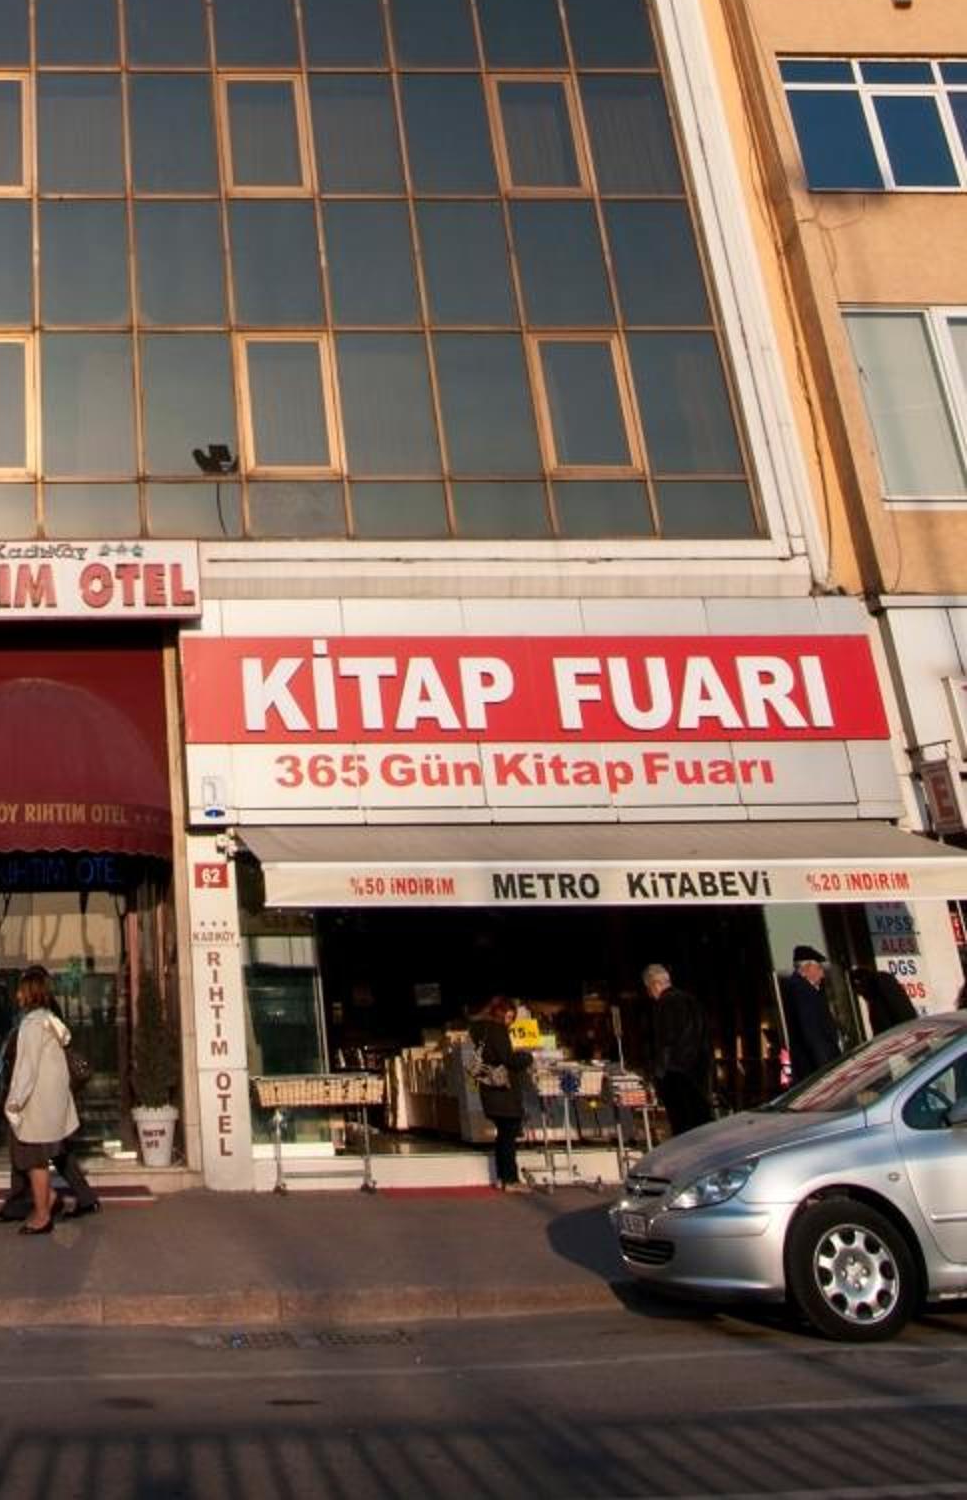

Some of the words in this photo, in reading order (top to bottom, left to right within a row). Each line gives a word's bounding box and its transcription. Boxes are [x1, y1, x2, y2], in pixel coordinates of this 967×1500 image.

[79, 563, 196, 609] OTEL
[241, 638, 515, 731] KİTAP
[552, 655, 835, 731] FUARI
[275, 754, 370, 788] 365
[380, 753, 483, 787] Gün
[492, 752, 634, 793] Kitap
[24, 803, 85, 824] RIHTIM
[91, 804, 127, 824] OTEL
[202, 867, 221, 883] 62
[350, 877, 384, 896] %50
[492, 873, 601, 900] METRO
[807, 873, 841, 892] %20
[888, 959, 918, 976] DGS
[207, 952, 229, 1056] RIHTIM
[216, 1073, 233, 1156] OTEL
